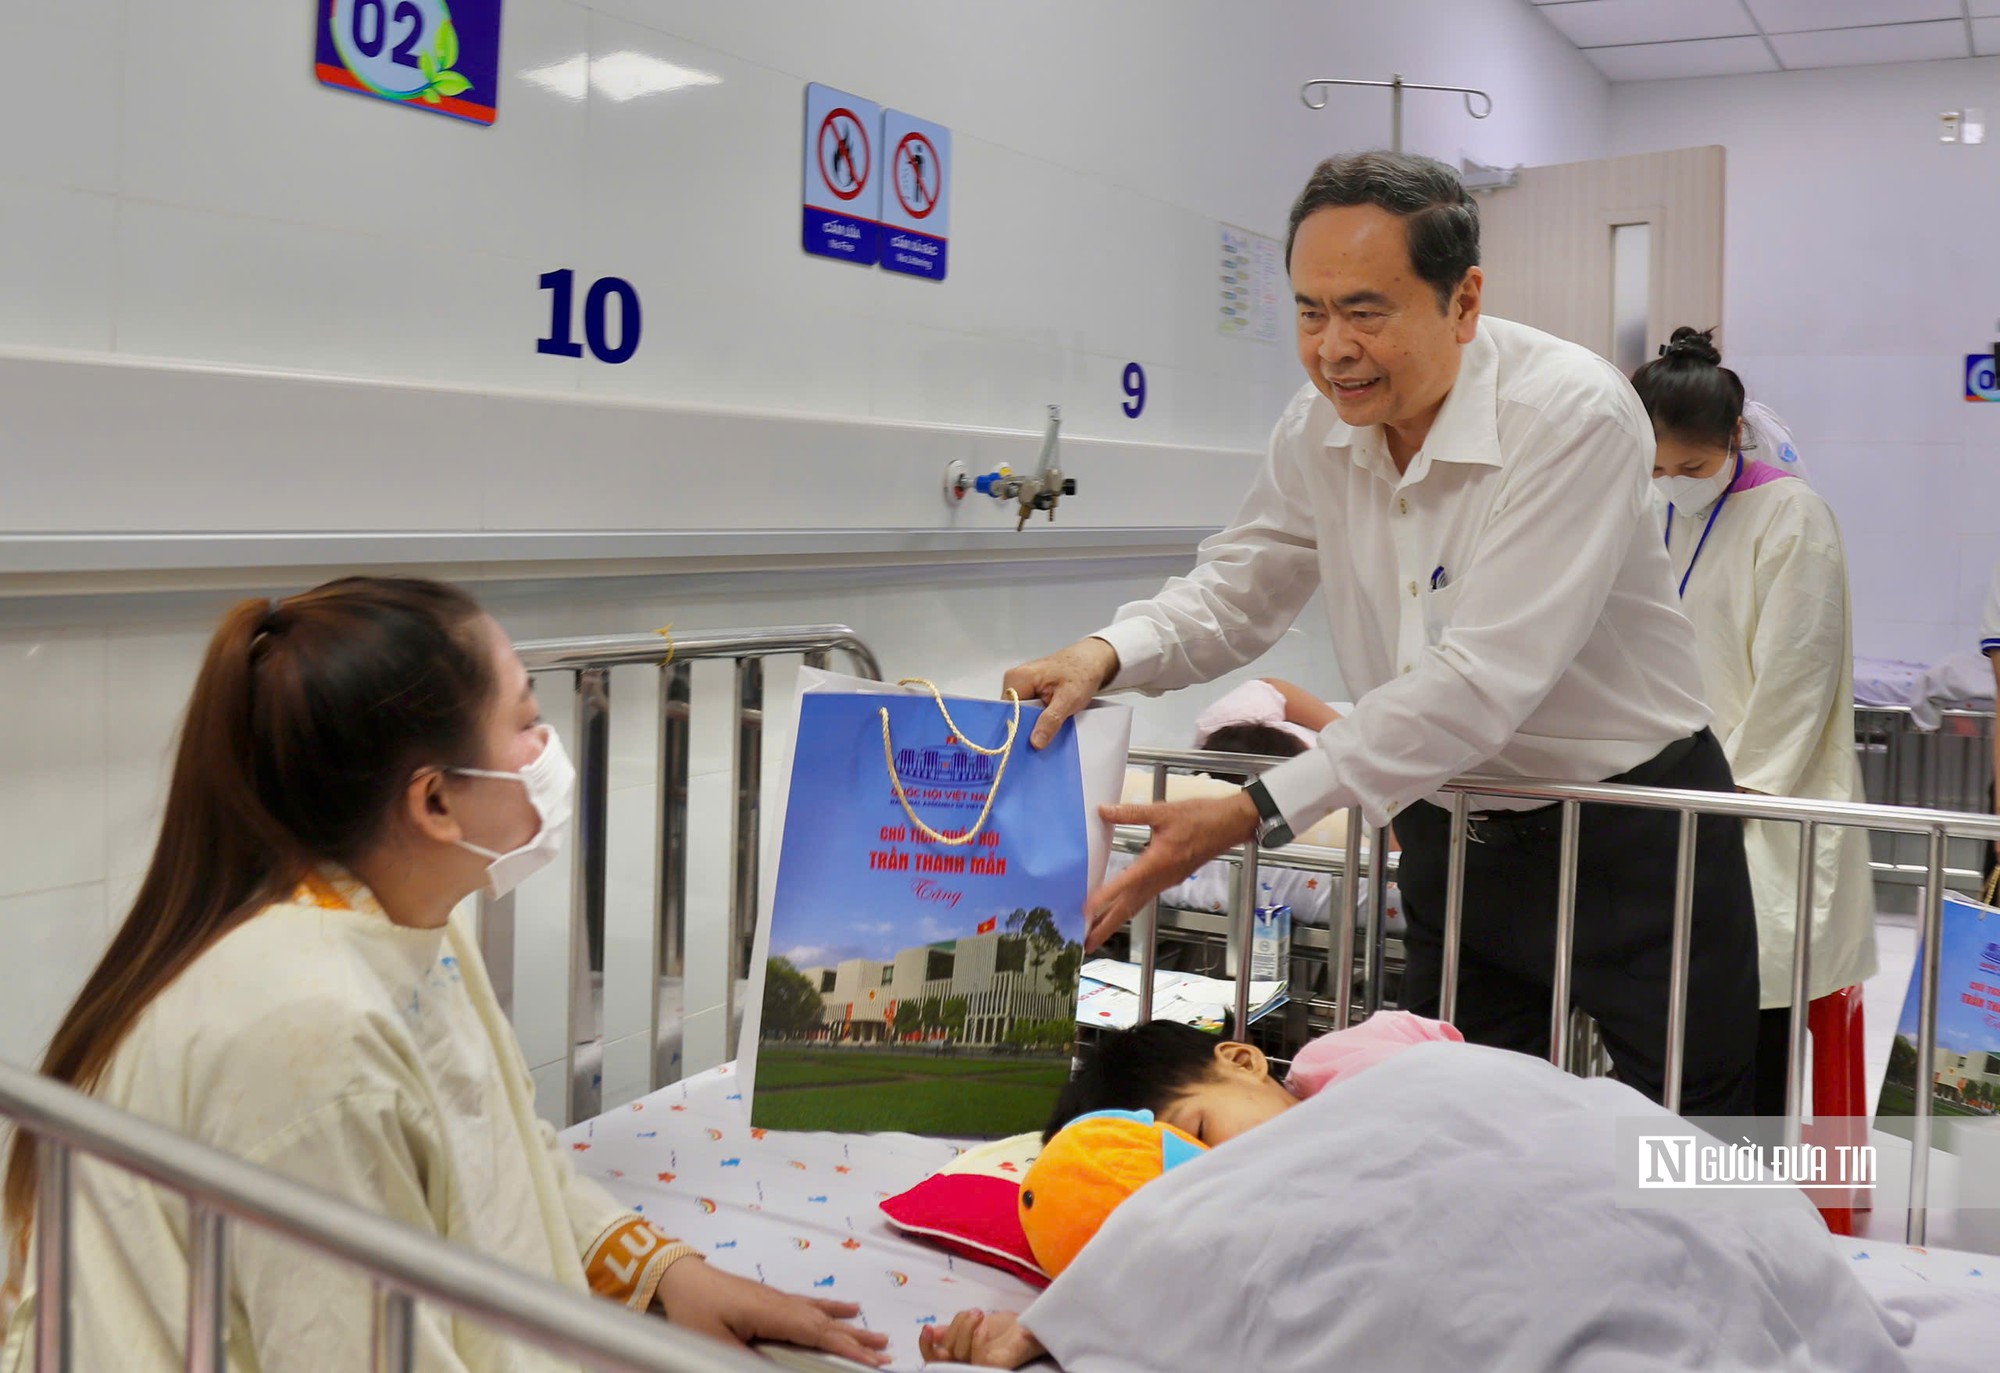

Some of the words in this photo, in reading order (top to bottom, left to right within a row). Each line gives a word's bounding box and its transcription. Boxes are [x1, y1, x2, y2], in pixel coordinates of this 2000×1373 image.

[353, 0, 423, 70] 02
[536, 268, 642, 364] 10
[1121, 362, 1146, 419] 9
[923, 788, 942, 801] HỘI
[880, 823, 906, 843] CHỦ
[979, 829, 1000, 848] HỘI
[869, 845, 909, 870] TRẦN
[914, 853, 965, 875] THANH
[913, 880, 962, 909] Tặng
